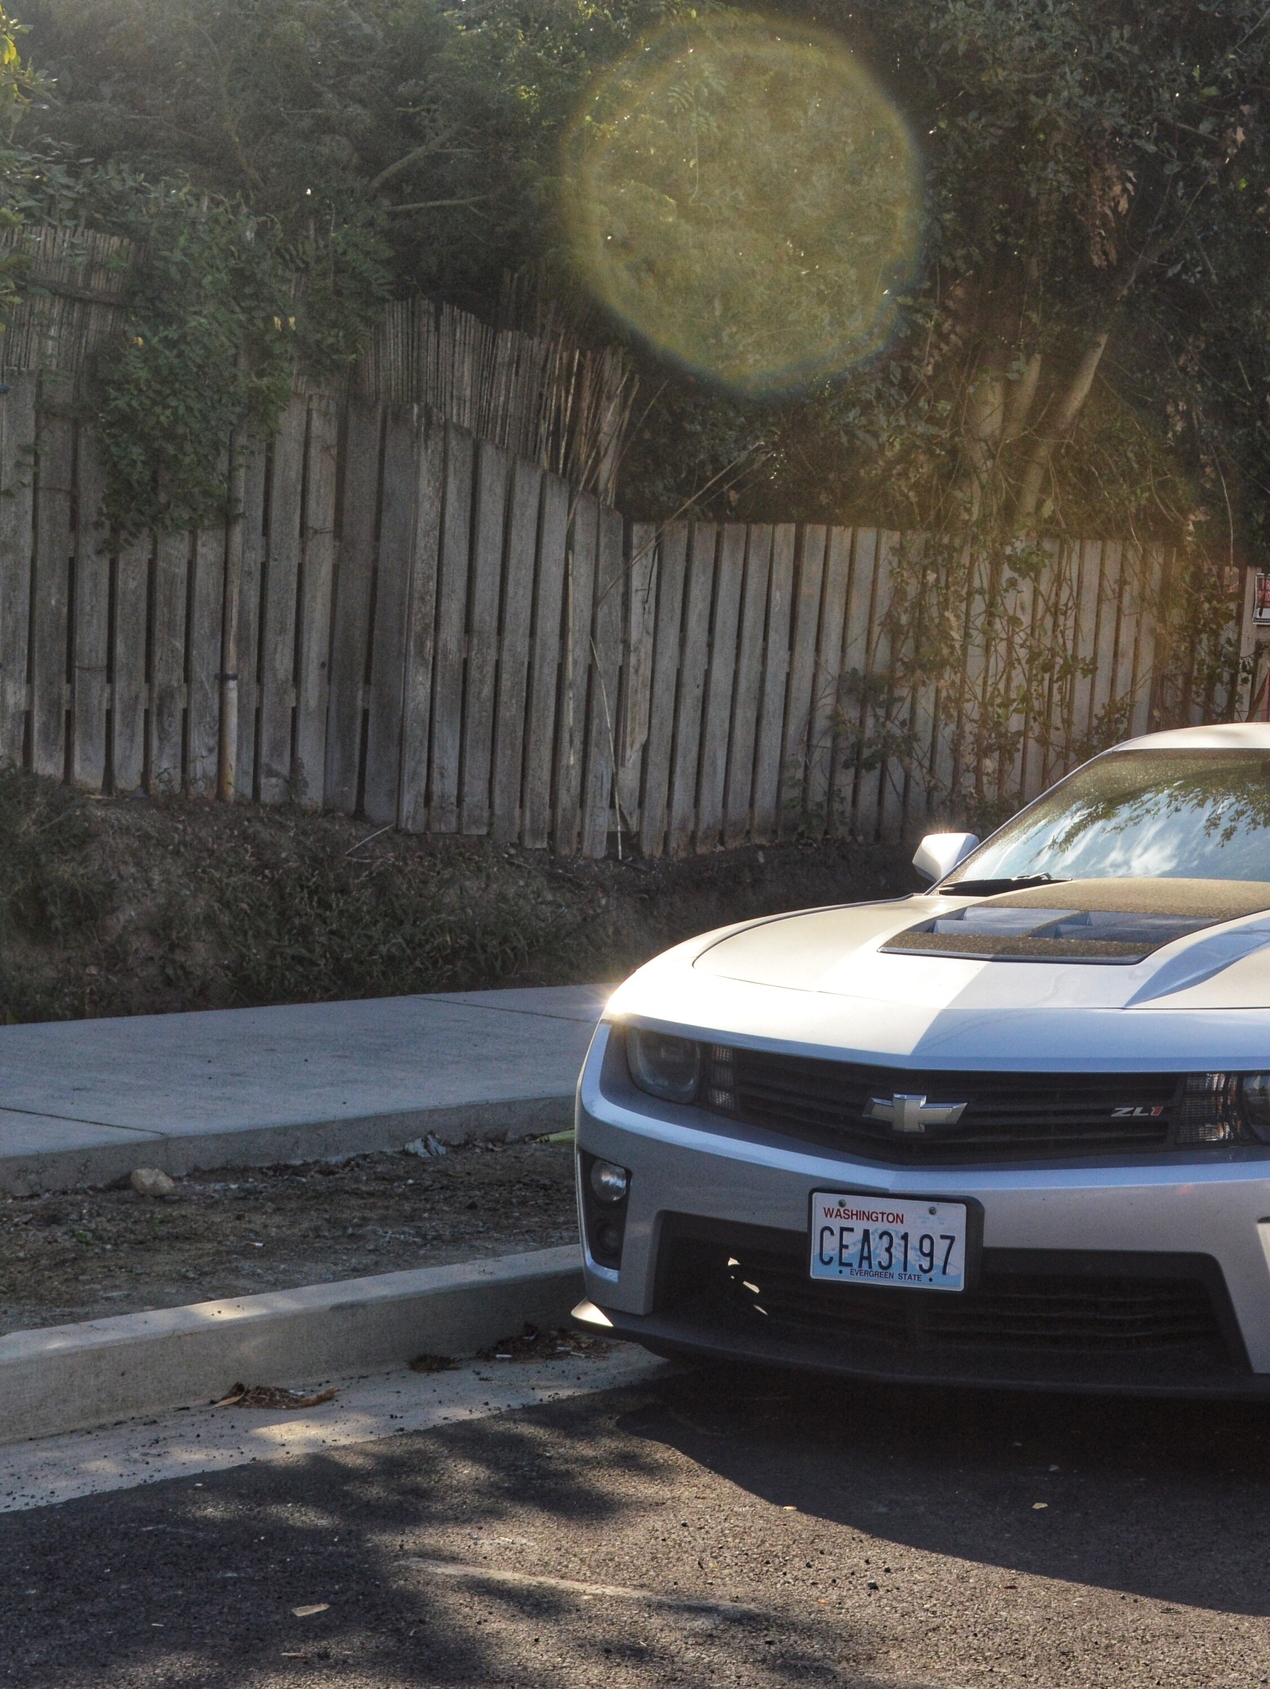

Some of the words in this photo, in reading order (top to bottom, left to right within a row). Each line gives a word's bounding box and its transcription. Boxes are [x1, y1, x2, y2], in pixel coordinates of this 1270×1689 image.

[1111, 1105, 1164, 1117] ZL1
[823, 1207, 904, 1225] WASHINGTON
[819, 1226, 956, 1275] CEA3197
[850, 1269, 894, 1279] EVERGREEN
[898, 1273, 922, 1282] STATE
